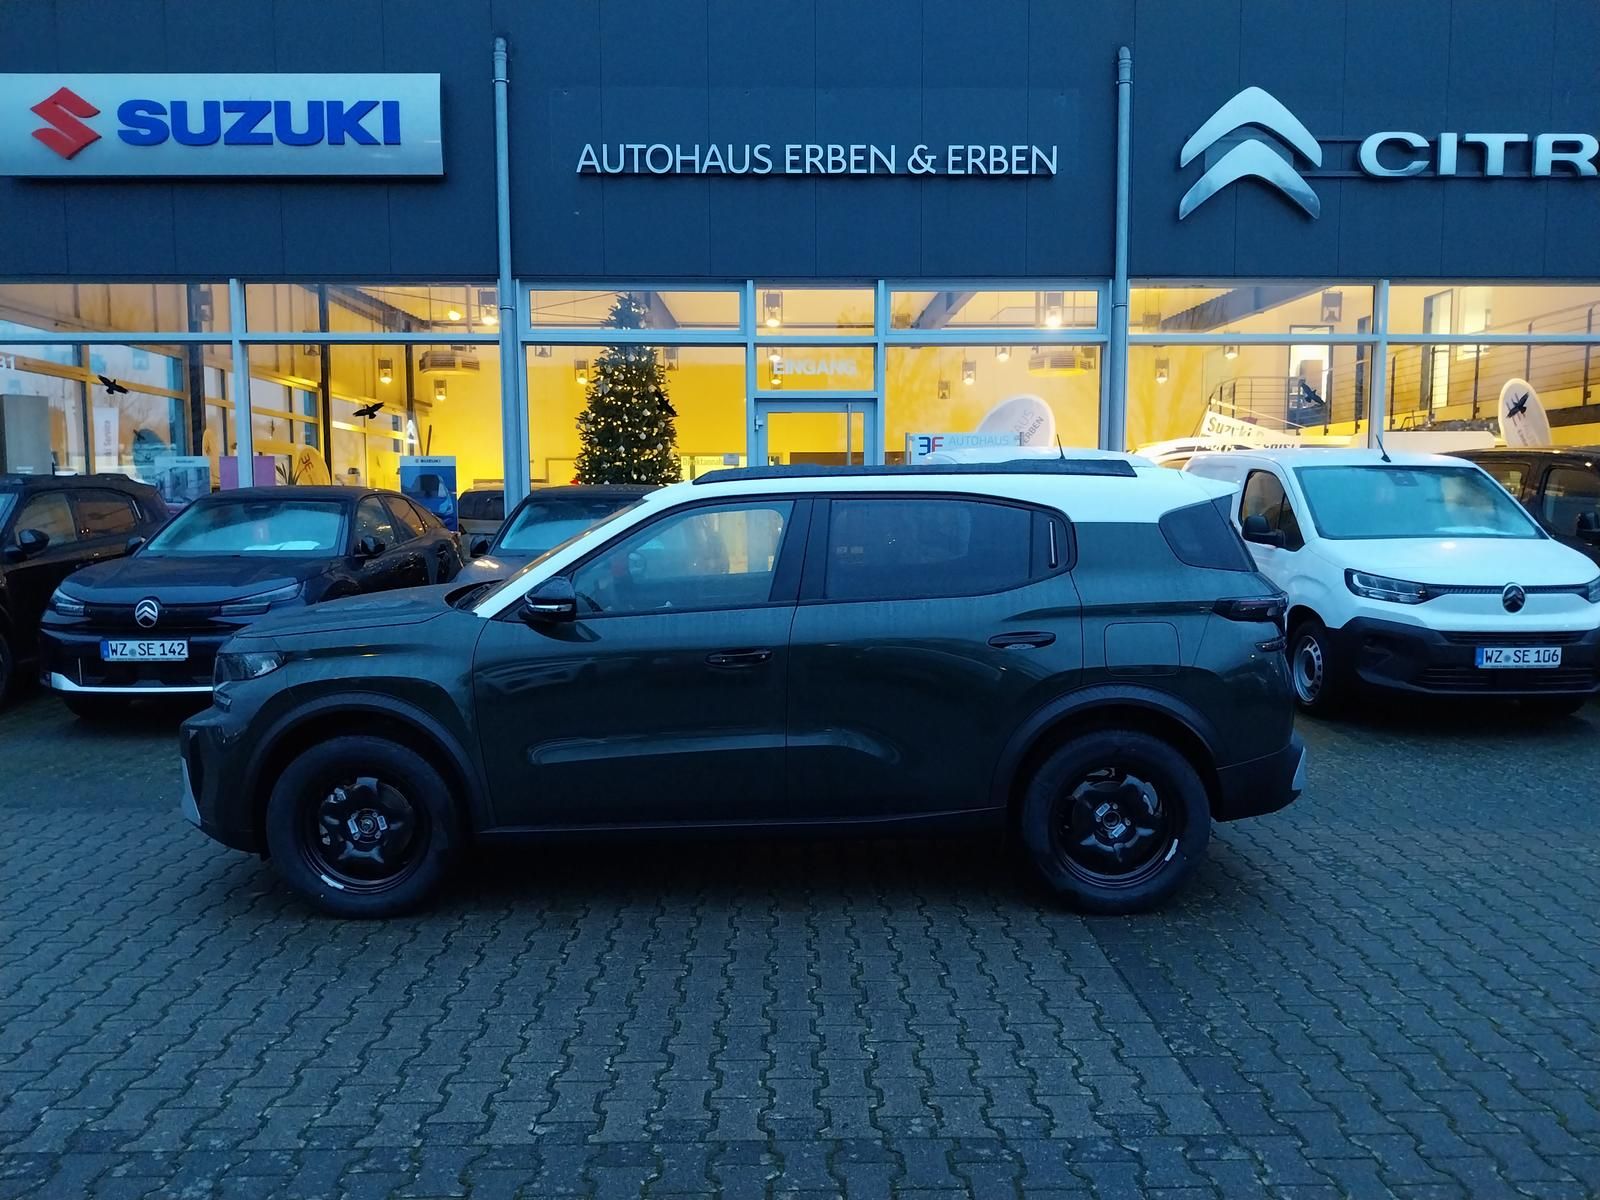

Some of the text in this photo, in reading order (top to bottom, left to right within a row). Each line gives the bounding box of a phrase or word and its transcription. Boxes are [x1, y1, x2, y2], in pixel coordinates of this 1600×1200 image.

[117, 99, 401, 146] SUZUKI
[576, 143, 1058, 175] AUTOHAUS ERBEN & ERBEN
[773, 357, 857, 376] EINGANG
[951, 435, 1009, 446] AUTOHAUS
[110, 643, 186, 656] WZ SE 142
[1485, 650, 1559, 663] WZ SE 106
